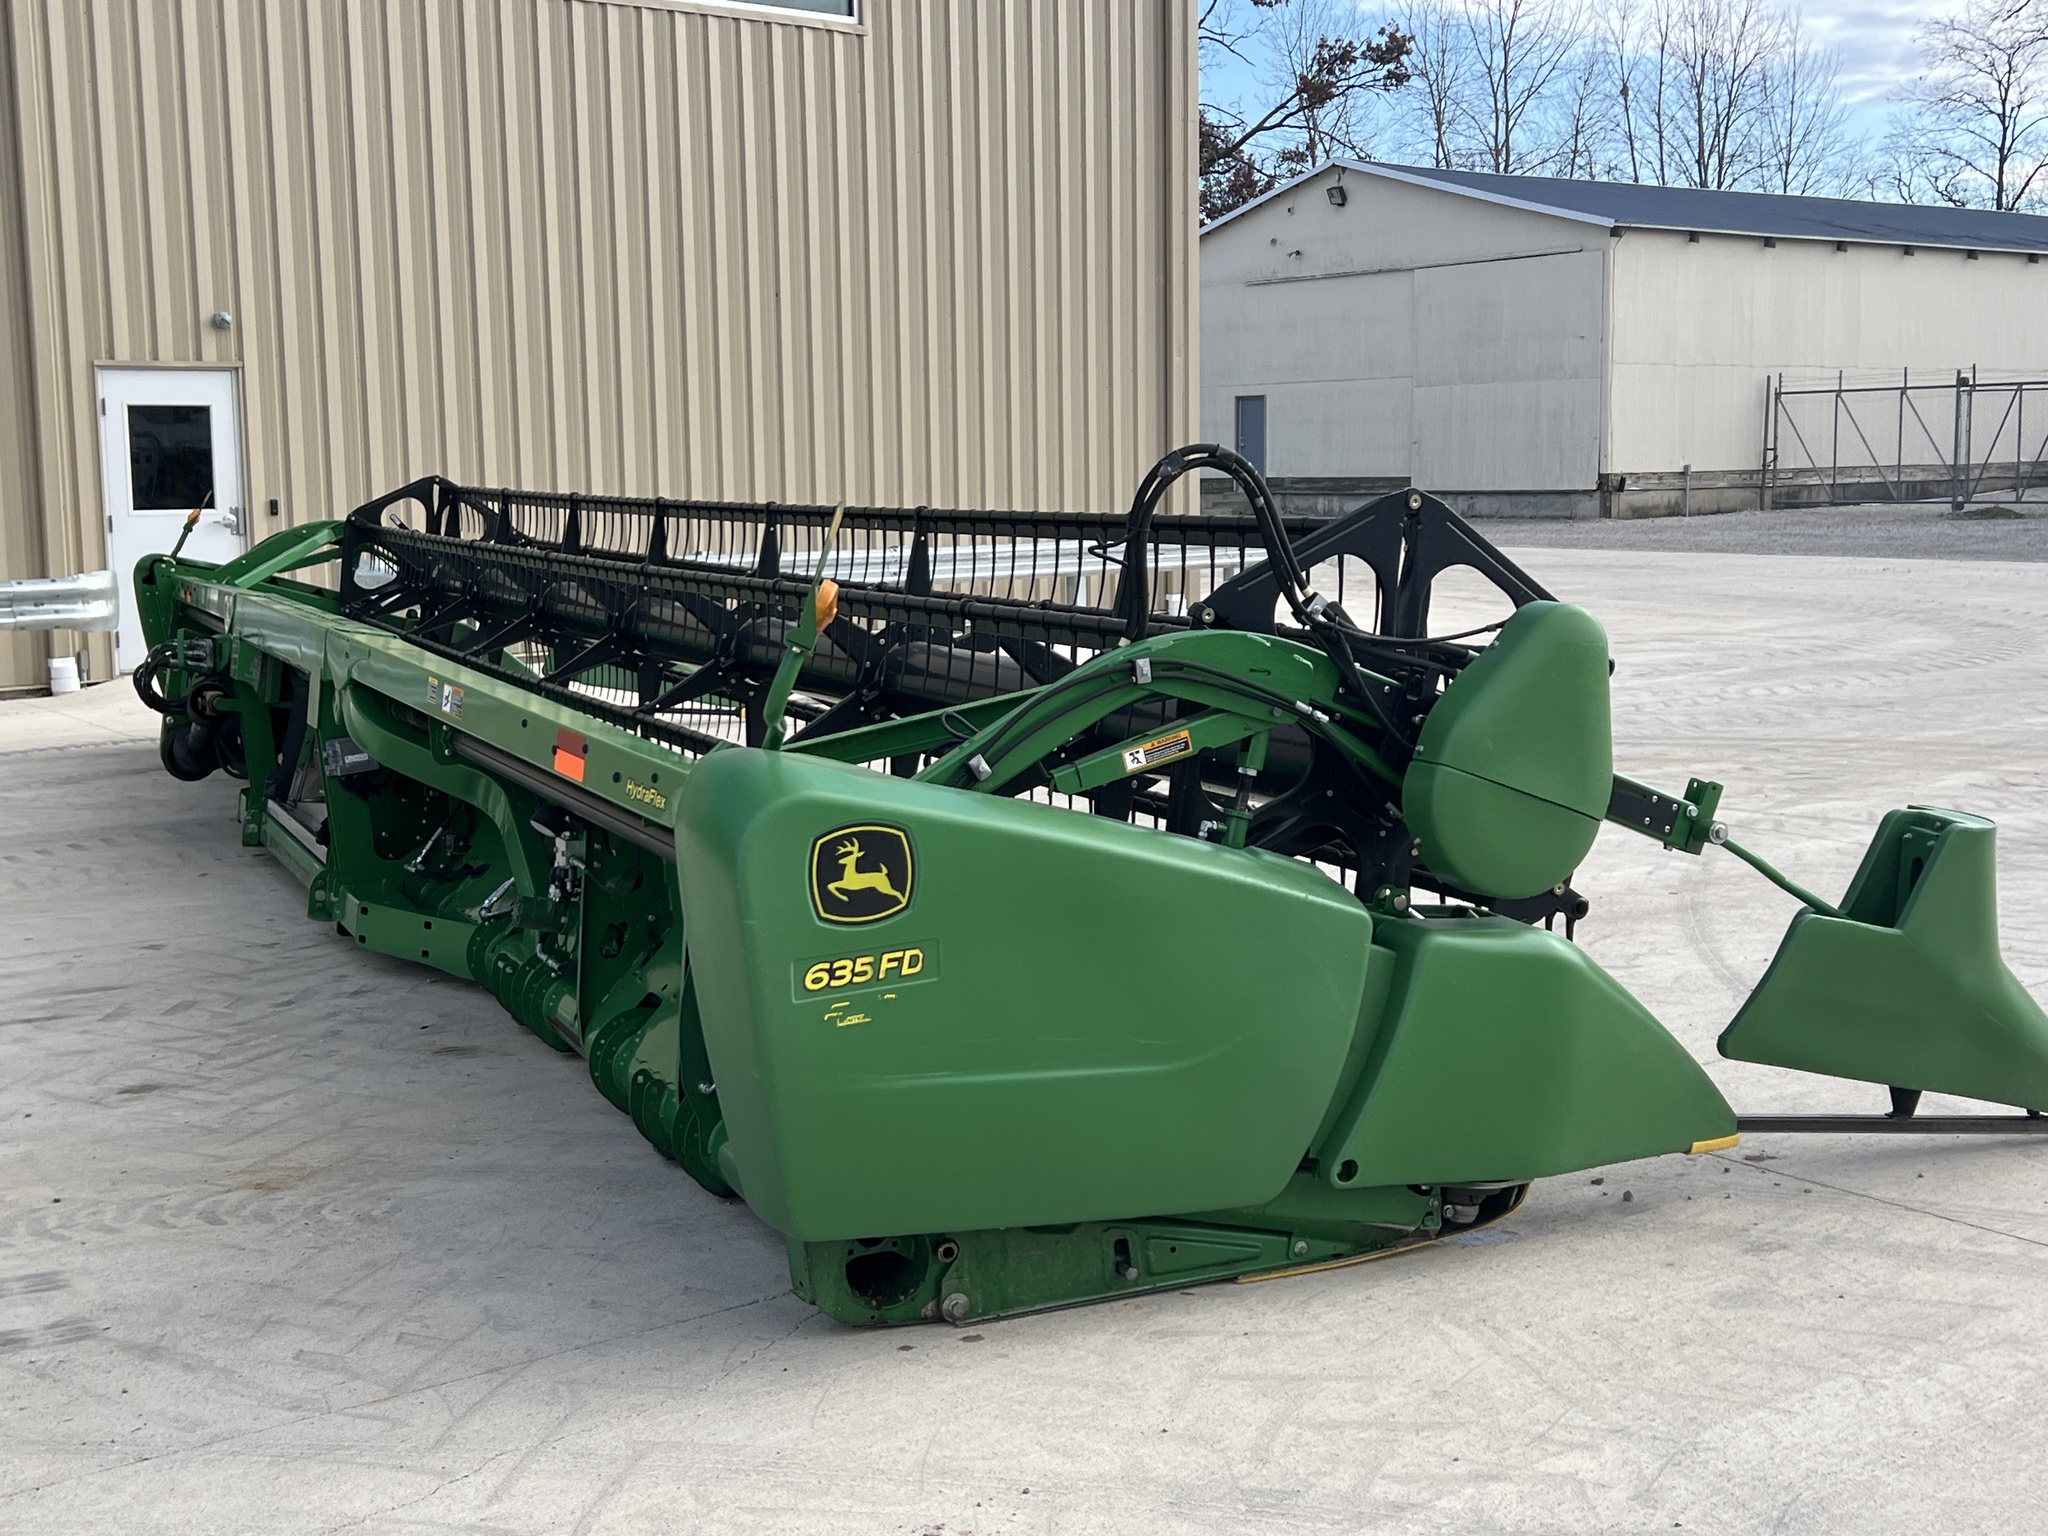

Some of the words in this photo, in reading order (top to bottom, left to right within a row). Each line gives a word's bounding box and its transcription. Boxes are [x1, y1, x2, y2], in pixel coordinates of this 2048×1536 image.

[626, 779, 666, 809] HydraFlex
[803, 954, 875, 992] 635
[877, 948, 924, 981] FD
